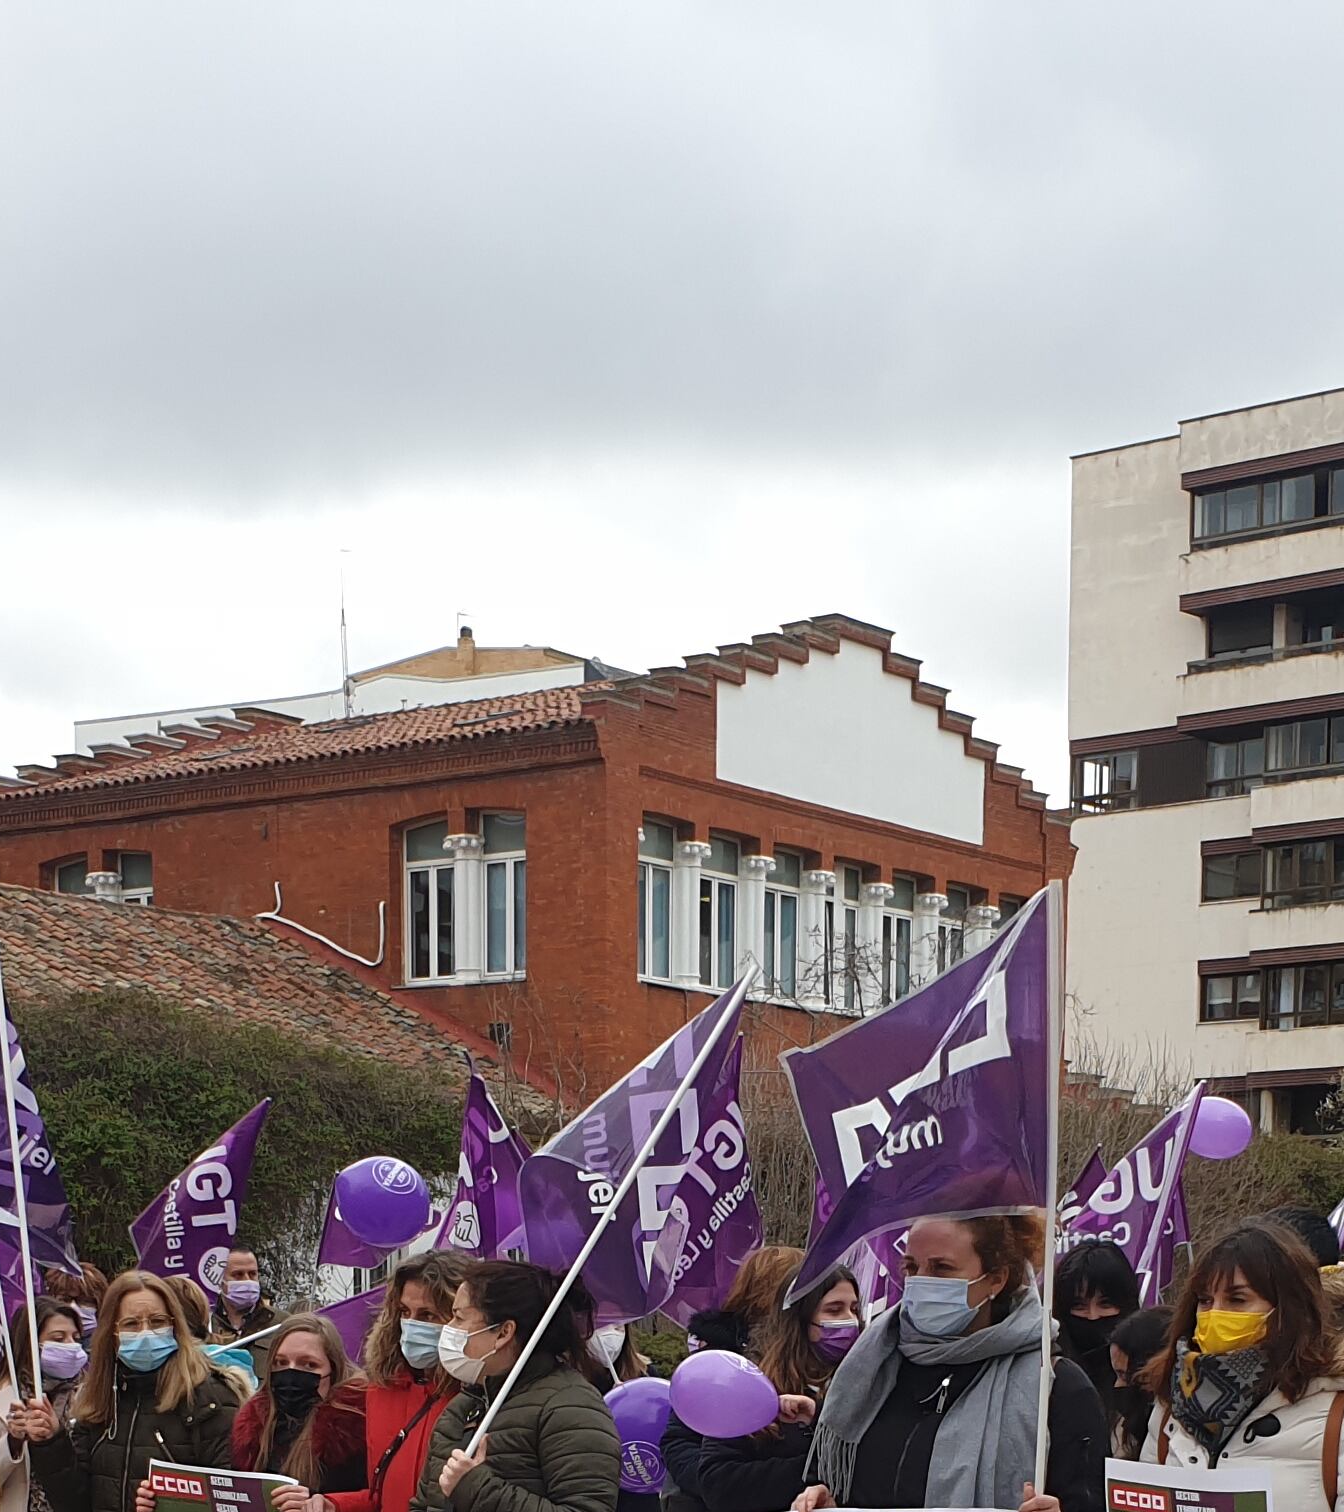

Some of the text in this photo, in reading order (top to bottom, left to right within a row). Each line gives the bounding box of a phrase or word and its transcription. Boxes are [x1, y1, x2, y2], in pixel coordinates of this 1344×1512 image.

[163, 1178, 186, 1269] Castilla y
[152, 1475, 203, 1496] CCOO
[1113, 1489, 1166, 1511] CCOO
